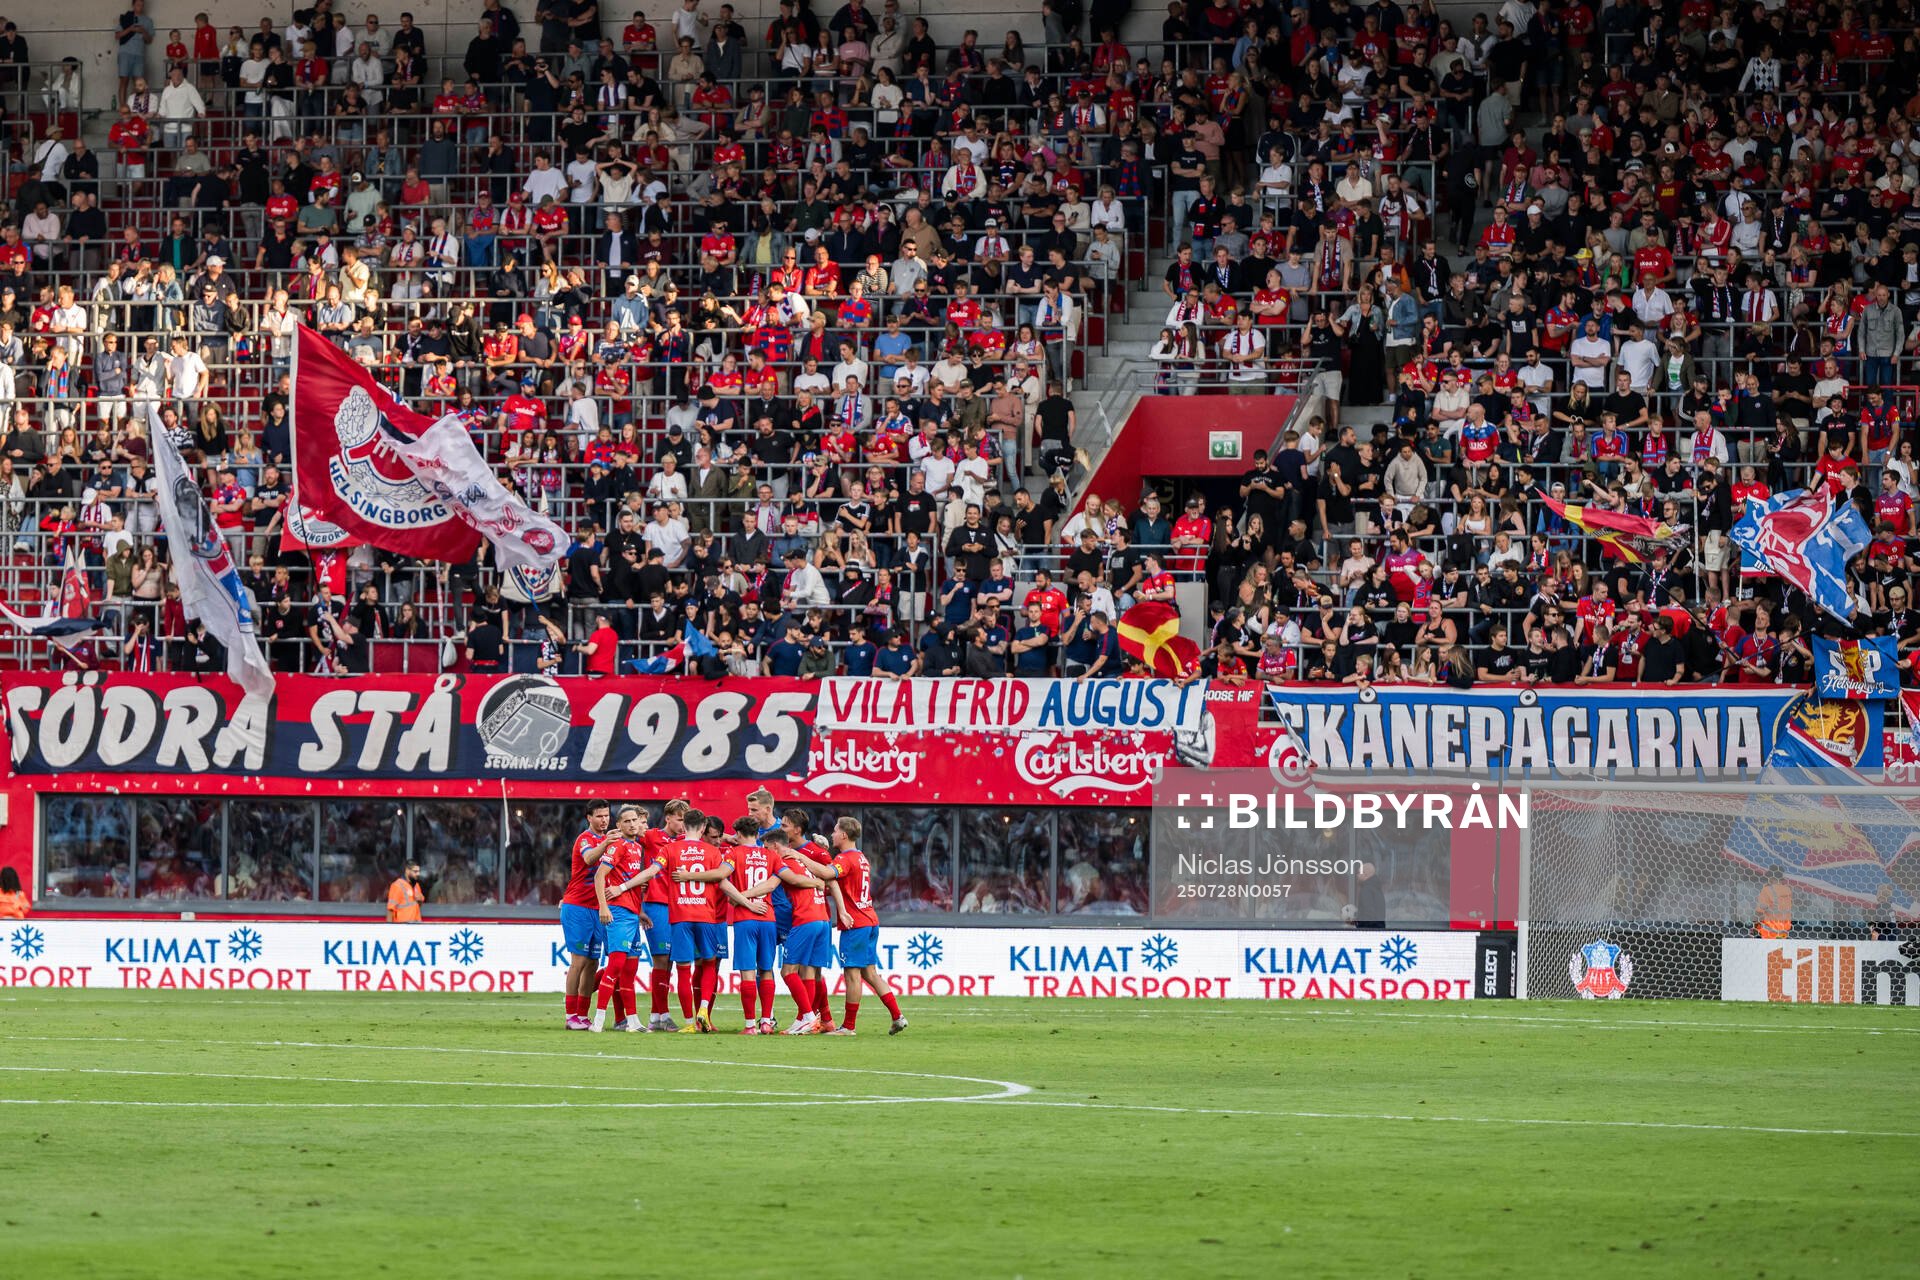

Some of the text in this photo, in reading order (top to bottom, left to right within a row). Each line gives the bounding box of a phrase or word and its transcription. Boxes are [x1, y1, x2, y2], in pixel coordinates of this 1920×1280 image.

[329, 461, 448, 524] HELSINGBORG
[829, 679, 1200, 728] VILA I FRID AUGUST
[1237, 690, 1254, 702] HIF
[6, 671, 812, 774] SÖDRA STÅ 1985
[484, 754, 568, 771] SEDAN 1985
[808, 731, 1166, 786] rlsberg Carlsberg
[860, 871, 870, 903] 5
[106, 938, 221, 963] KLIMAT
[324, 940, 442, 966] KLIMAT
[1010, 945, 1134, 972] KLIMAT
[1245, 947, 1372, 974] KLIMAT
[118, 967, 311, 990] TRANSPORT
[337, 969, 534, 992] TRANSPORT
[1484, 949, 1498, 996] SELECT
[1589, 972, 1612, 985] HIF
[1024, 975, 1231, 998] TRANSPORT
[1259, 977, 1471, 1000] TRANSPORT
